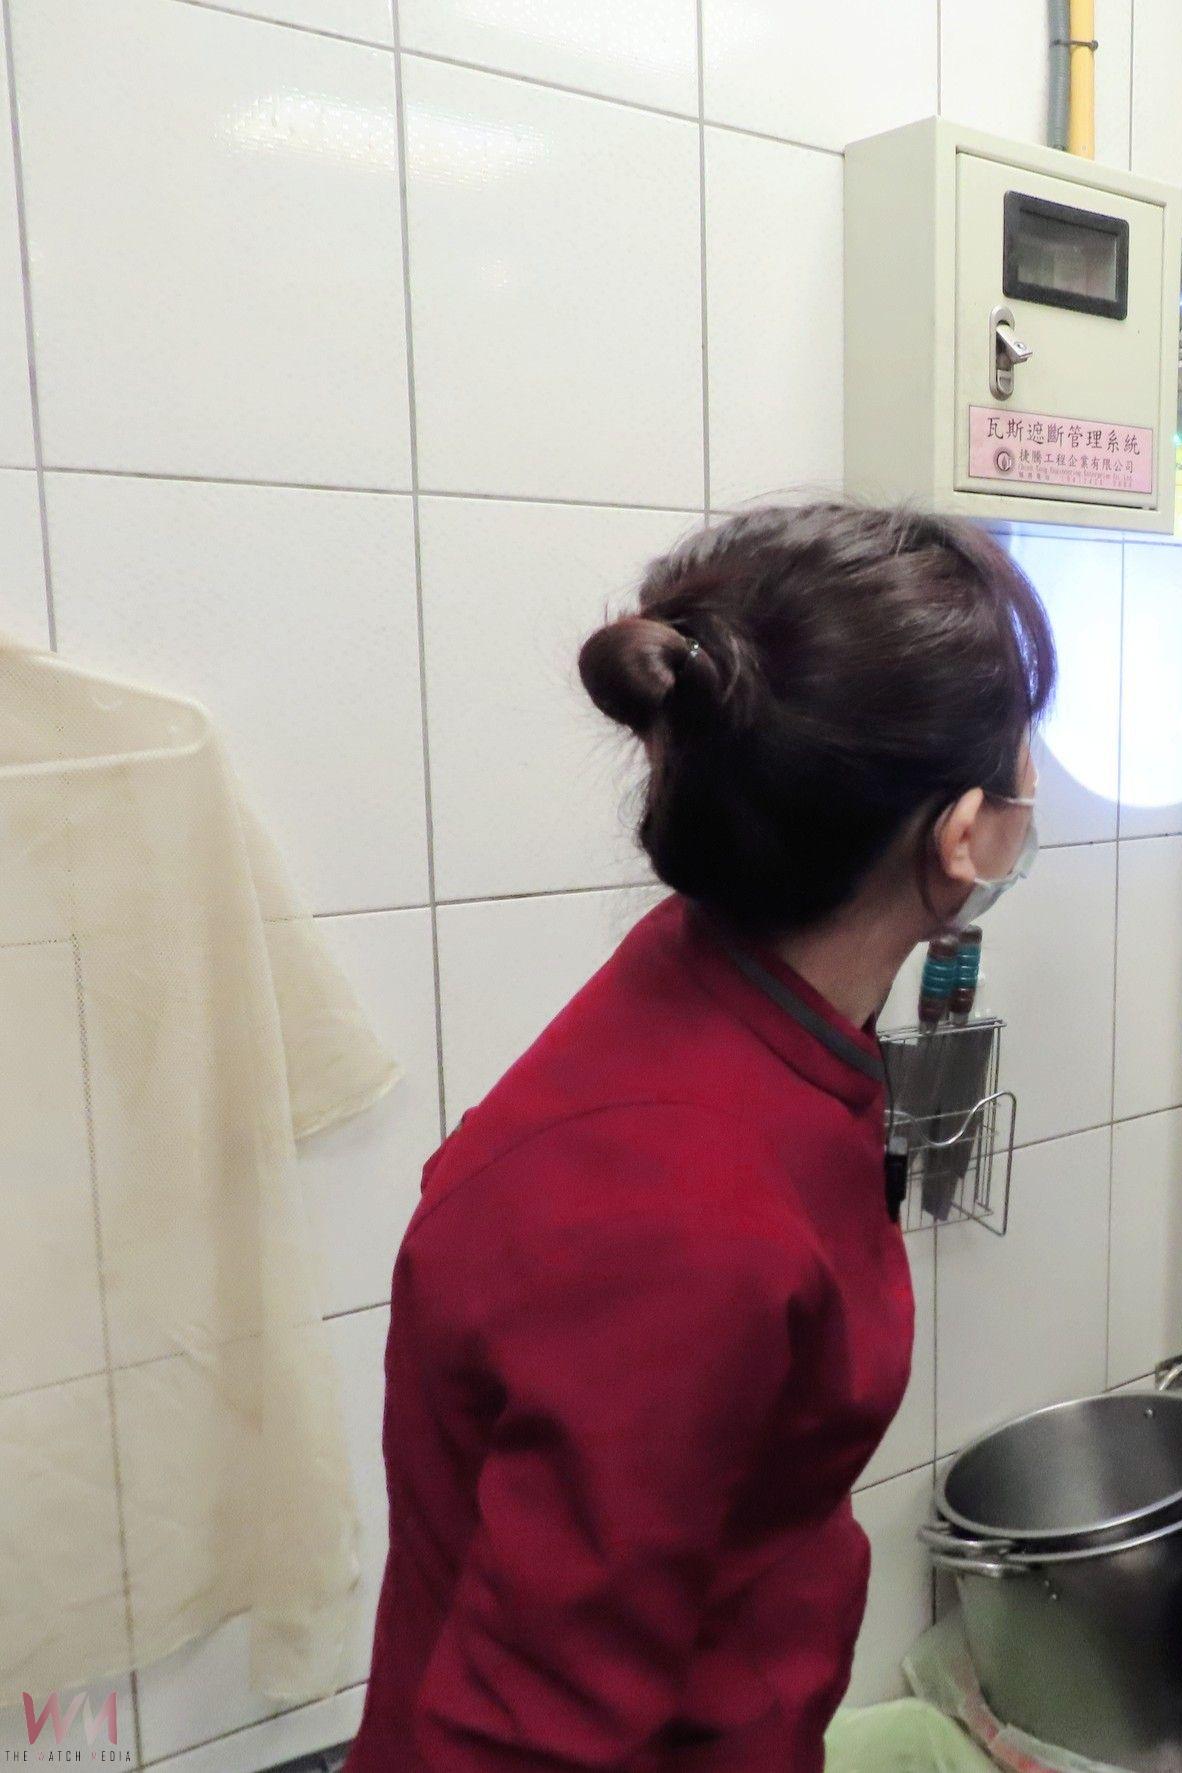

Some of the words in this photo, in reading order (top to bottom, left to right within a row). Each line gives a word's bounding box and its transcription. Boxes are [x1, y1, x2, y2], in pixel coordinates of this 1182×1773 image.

[987, 417, 1142, 455] 瓦斯遮斷管理系統
